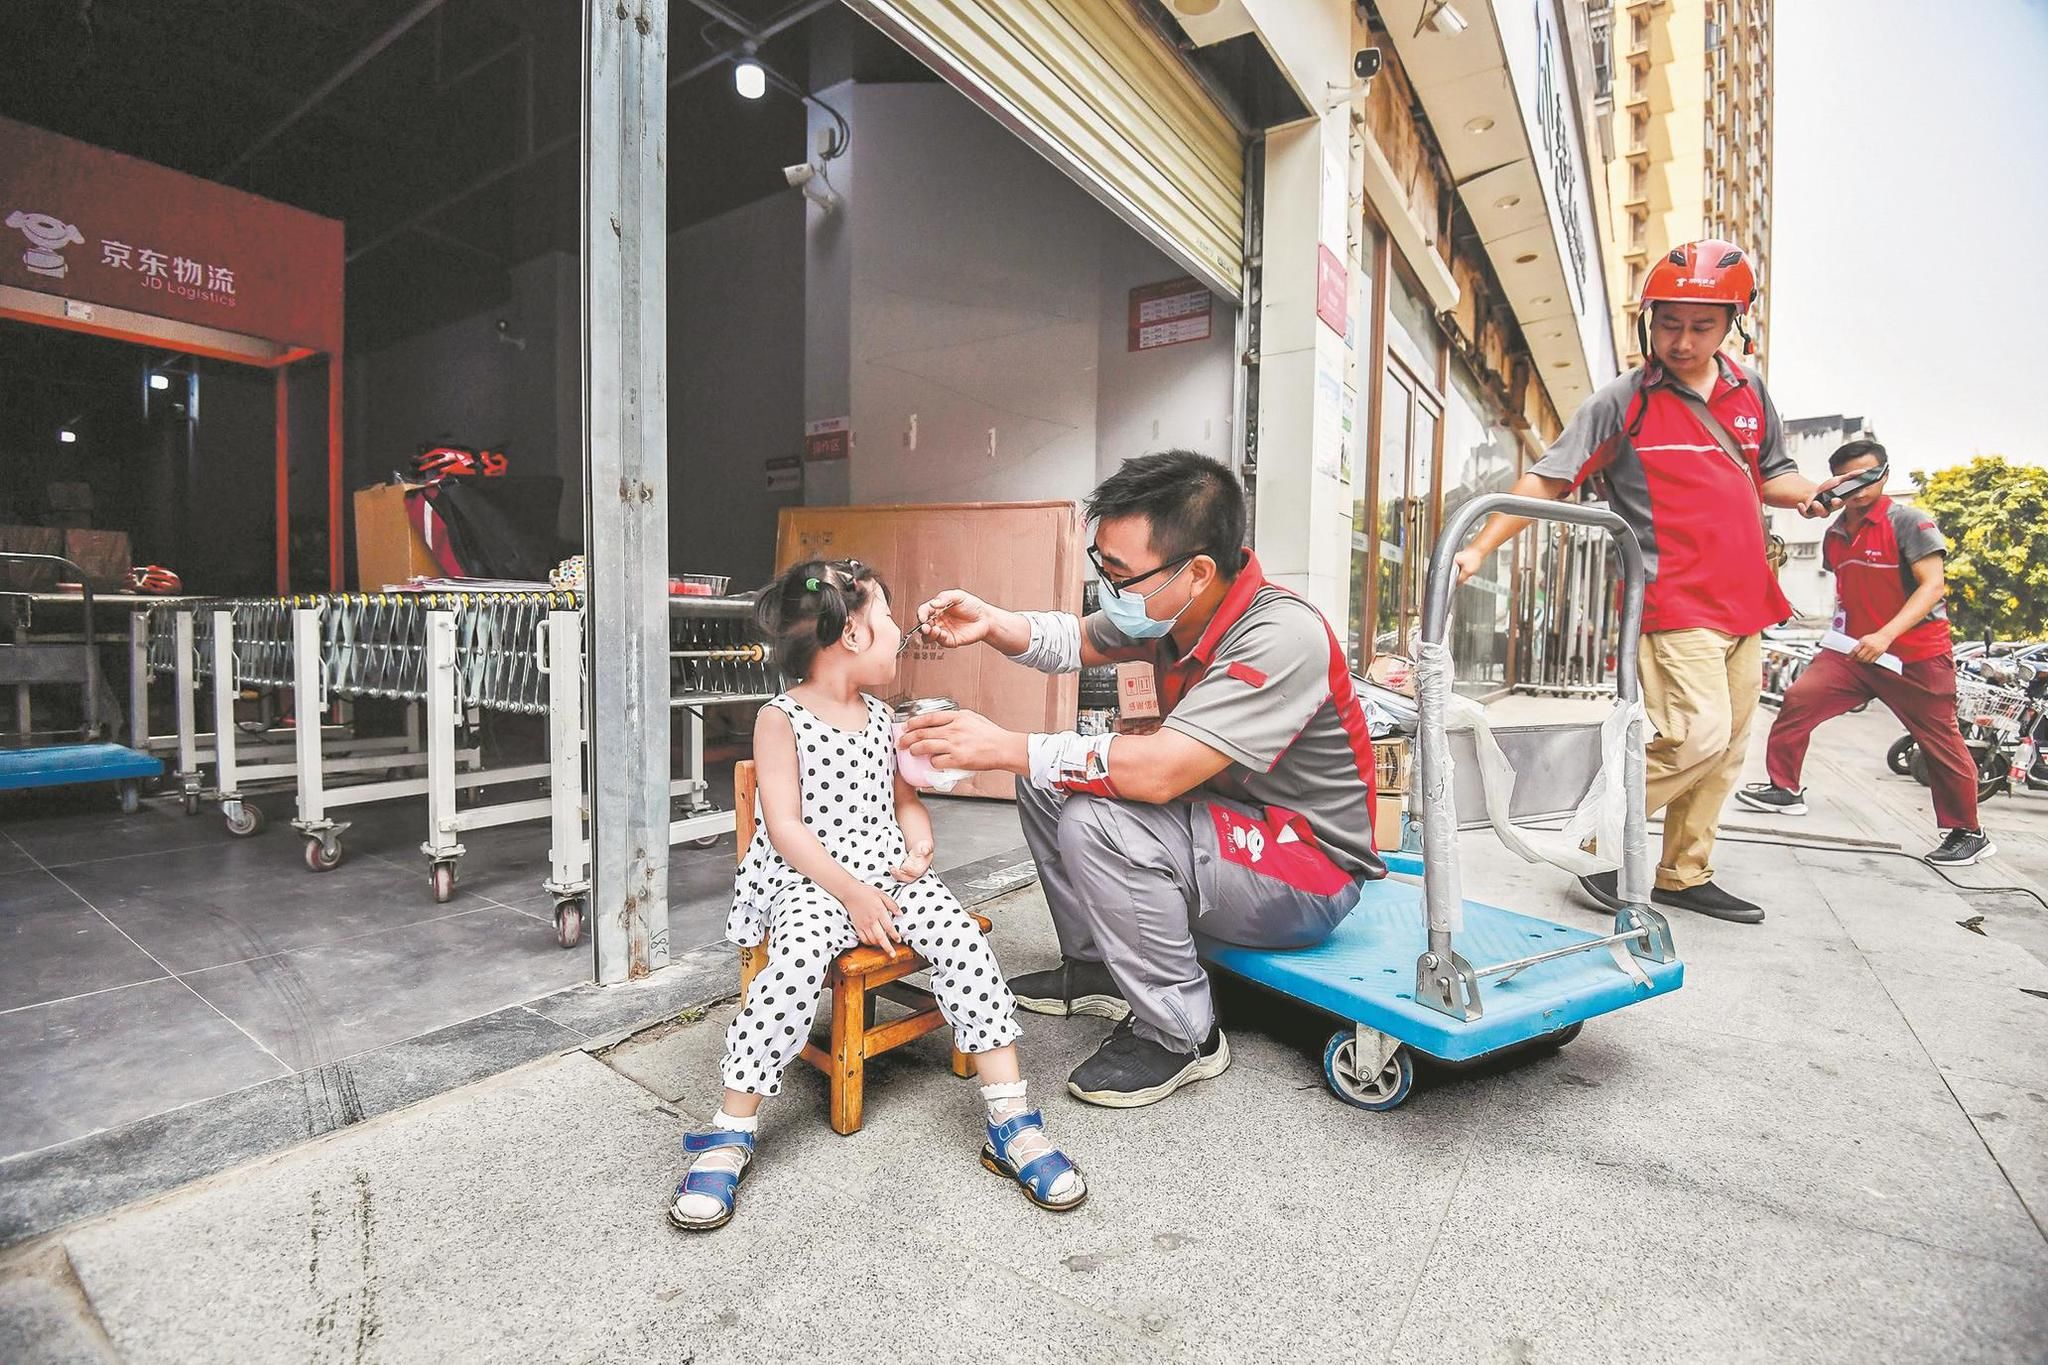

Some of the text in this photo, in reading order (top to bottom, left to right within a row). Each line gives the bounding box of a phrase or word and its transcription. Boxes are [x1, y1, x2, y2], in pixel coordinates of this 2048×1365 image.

[101, 239, 236, 294] 京东物流
[141, 276, 237, 308] JD Logistics
